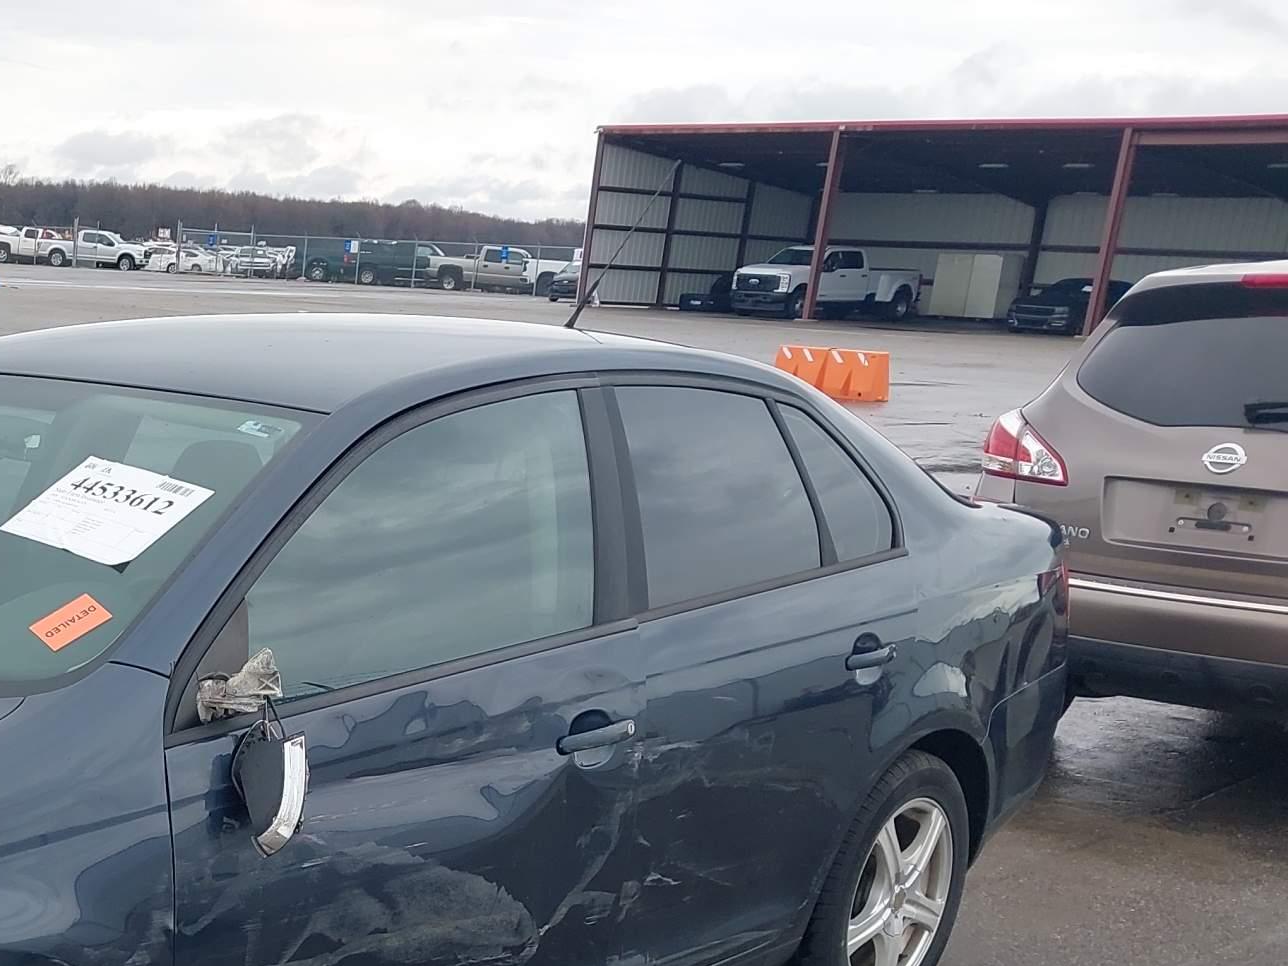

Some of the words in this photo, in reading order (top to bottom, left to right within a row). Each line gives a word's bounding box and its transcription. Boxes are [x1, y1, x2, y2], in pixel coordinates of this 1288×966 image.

[1207, 454, 1241, 462] NISSAN
[70, 477, 175, 516] 44533612
[45, 604, 97, 638] DETAILED
